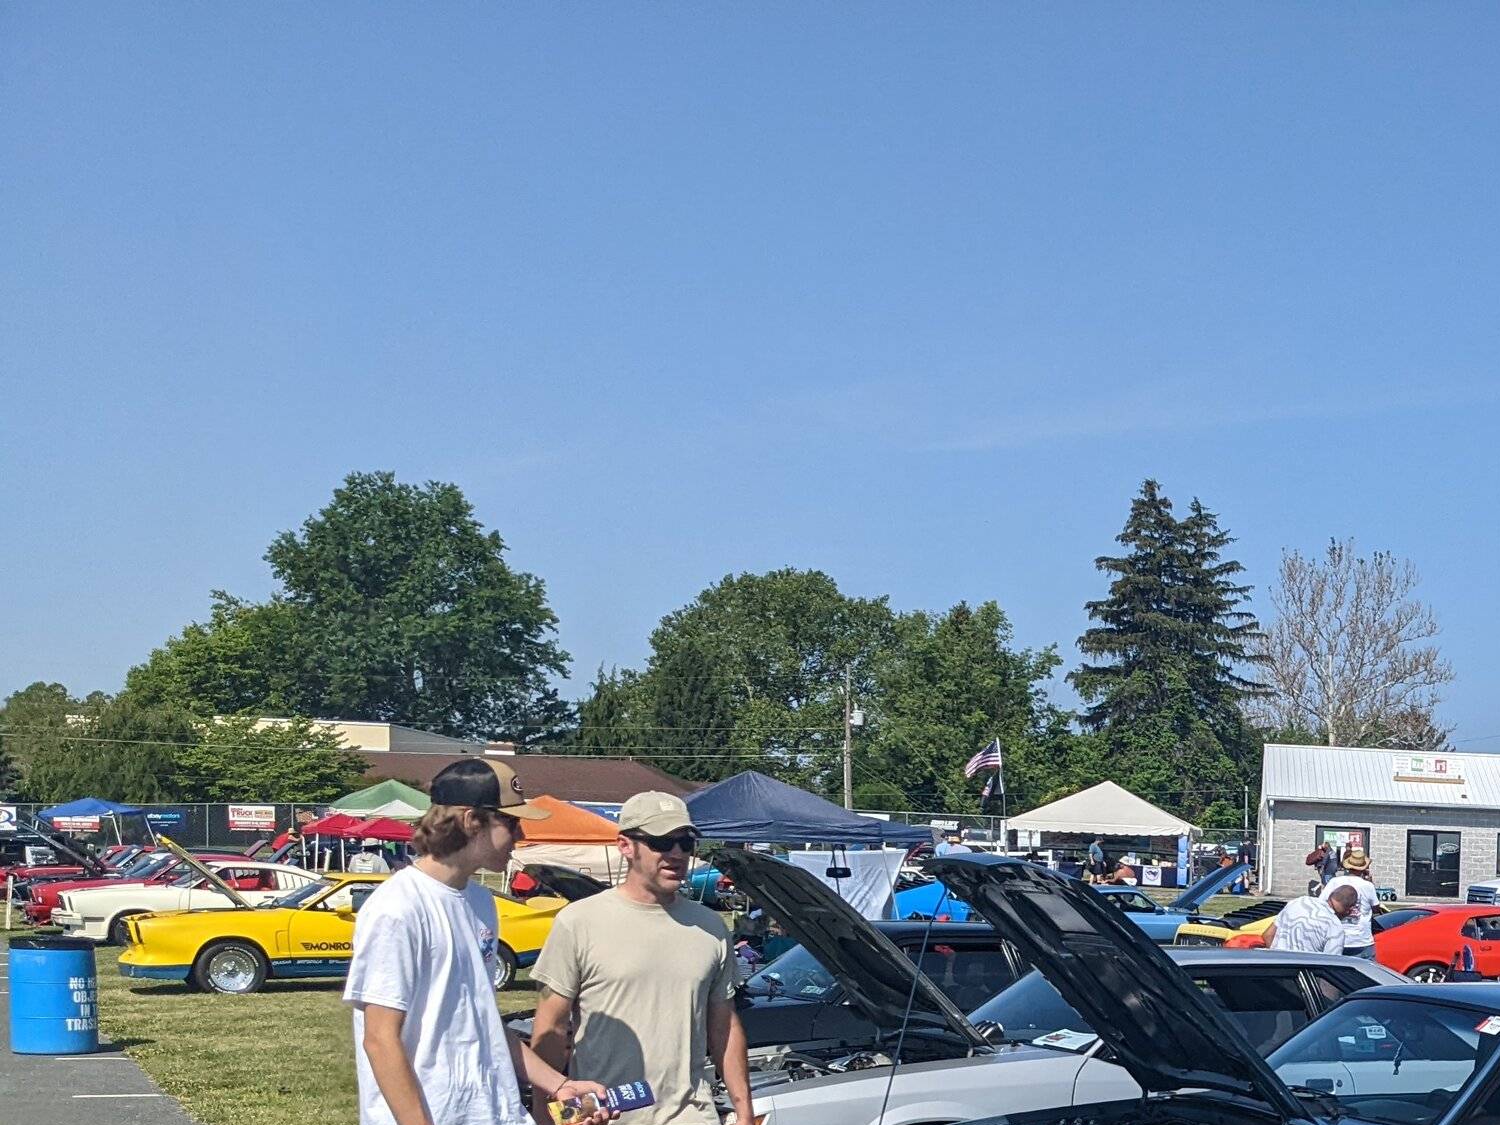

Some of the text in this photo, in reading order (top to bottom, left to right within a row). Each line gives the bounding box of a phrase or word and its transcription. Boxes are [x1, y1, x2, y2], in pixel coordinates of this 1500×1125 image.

[306, 942, 354, 951] MONRO
[69, 977, 85, 989] NO
[81, 1004, 91, 1016] IN
